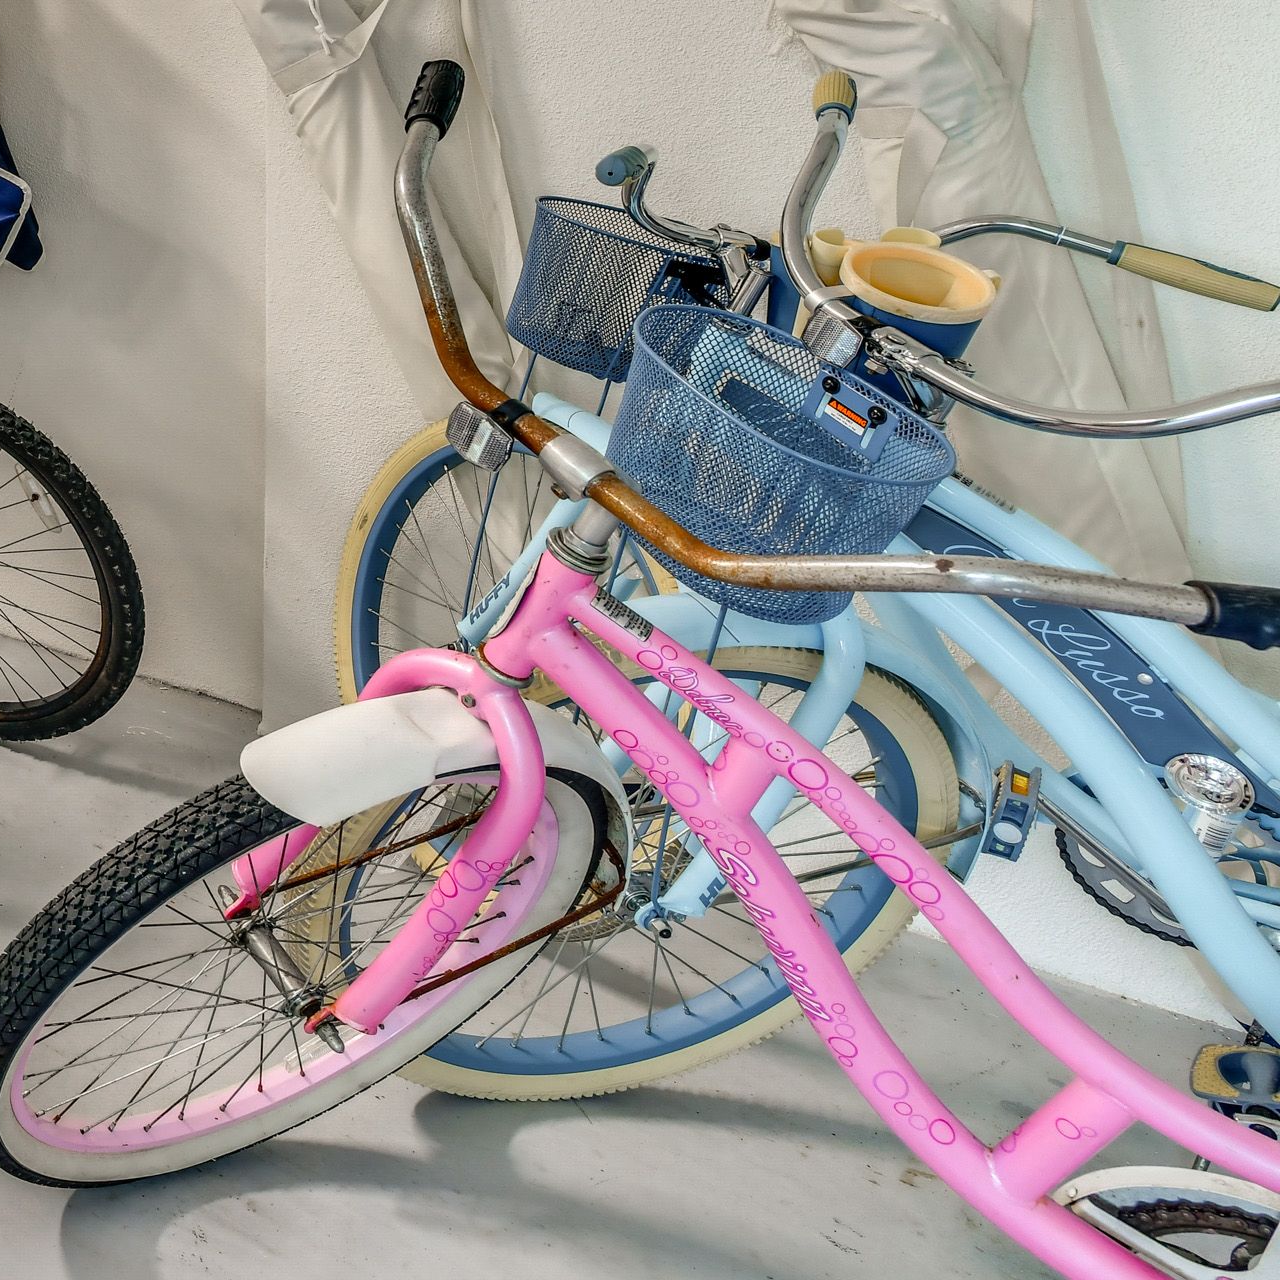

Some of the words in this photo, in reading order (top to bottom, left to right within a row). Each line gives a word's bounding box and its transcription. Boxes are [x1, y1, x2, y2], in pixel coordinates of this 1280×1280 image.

[837, 402, 868, 427] WARNING
[469, 570, 512, 626] HUFFY
[1027, 618, 1166, 720] Lusso
